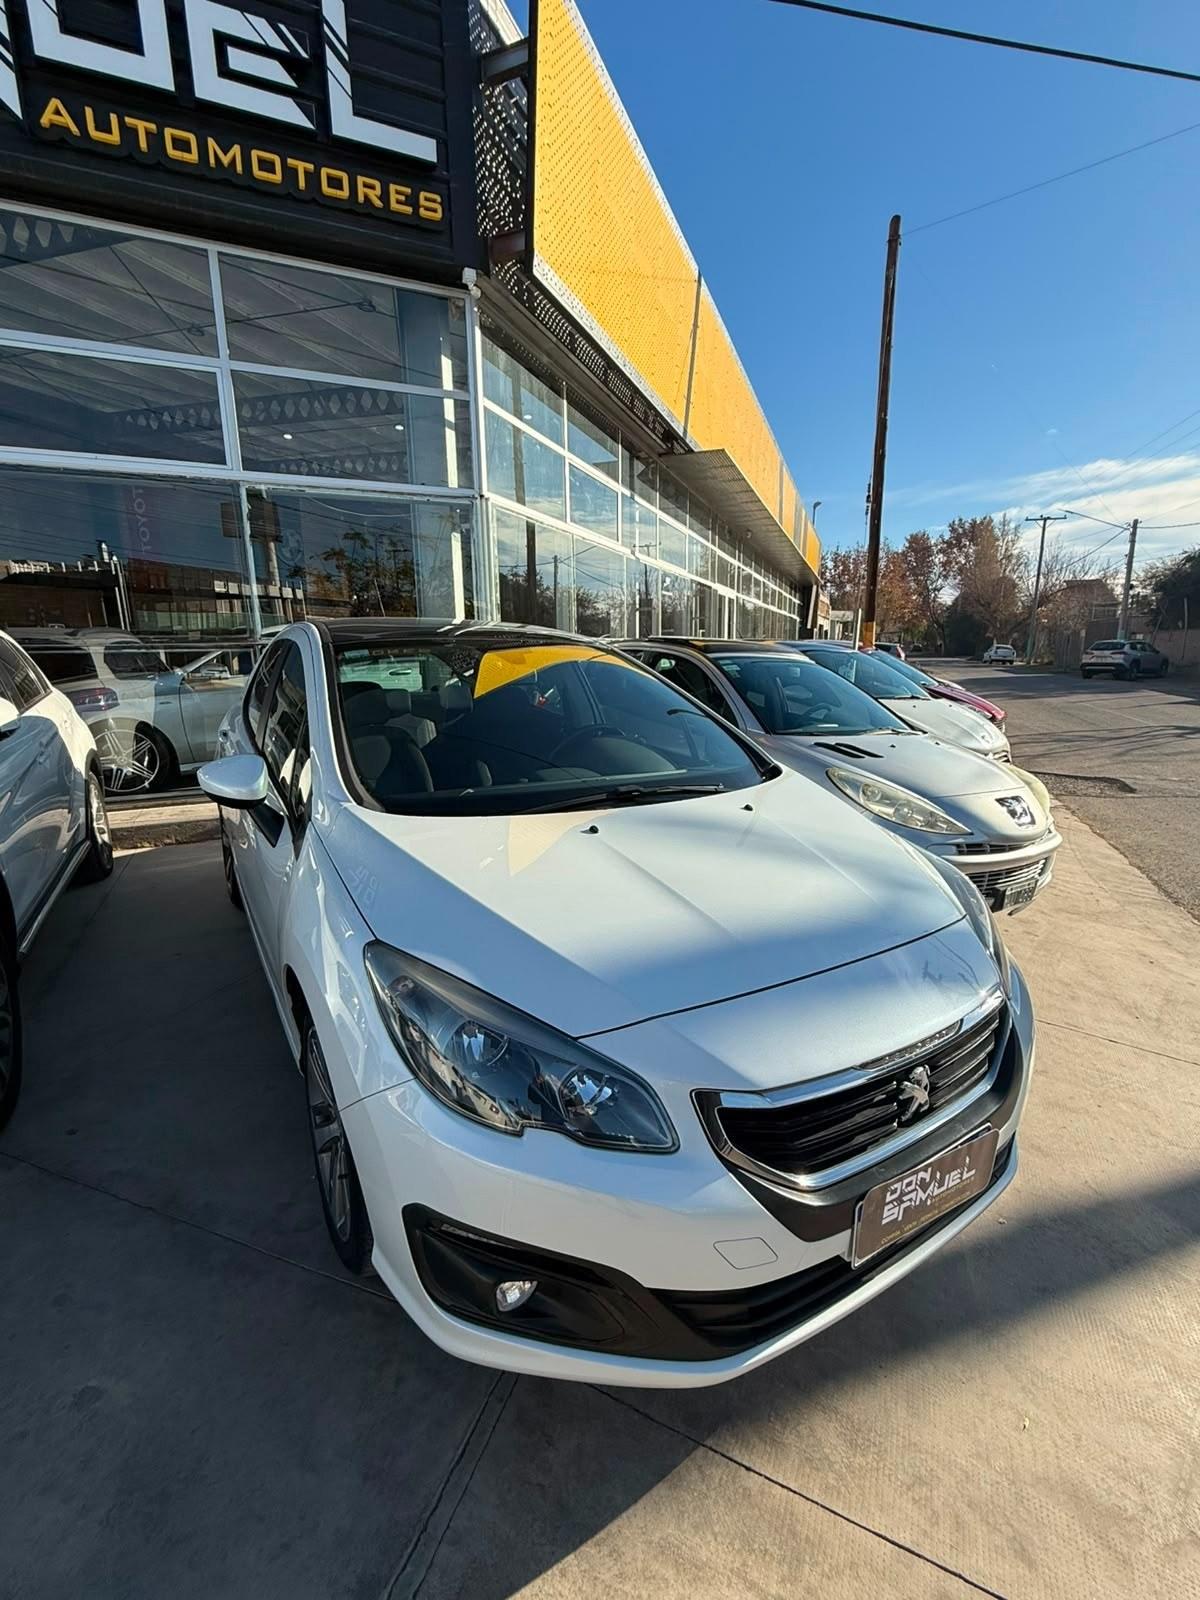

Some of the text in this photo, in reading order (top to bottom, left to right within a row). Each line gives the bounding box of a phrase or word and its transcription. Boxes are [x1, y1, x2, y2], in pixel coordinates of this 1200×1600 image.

[0, 0, 437, 163] UEL
[40, 98, 443, 221] AUTOMOTORES
[132, 486, 152, 554] TOYOT
[881, 1156, 976, 1225] SAMUEL
[885, 1167, 932, 1203] DON
